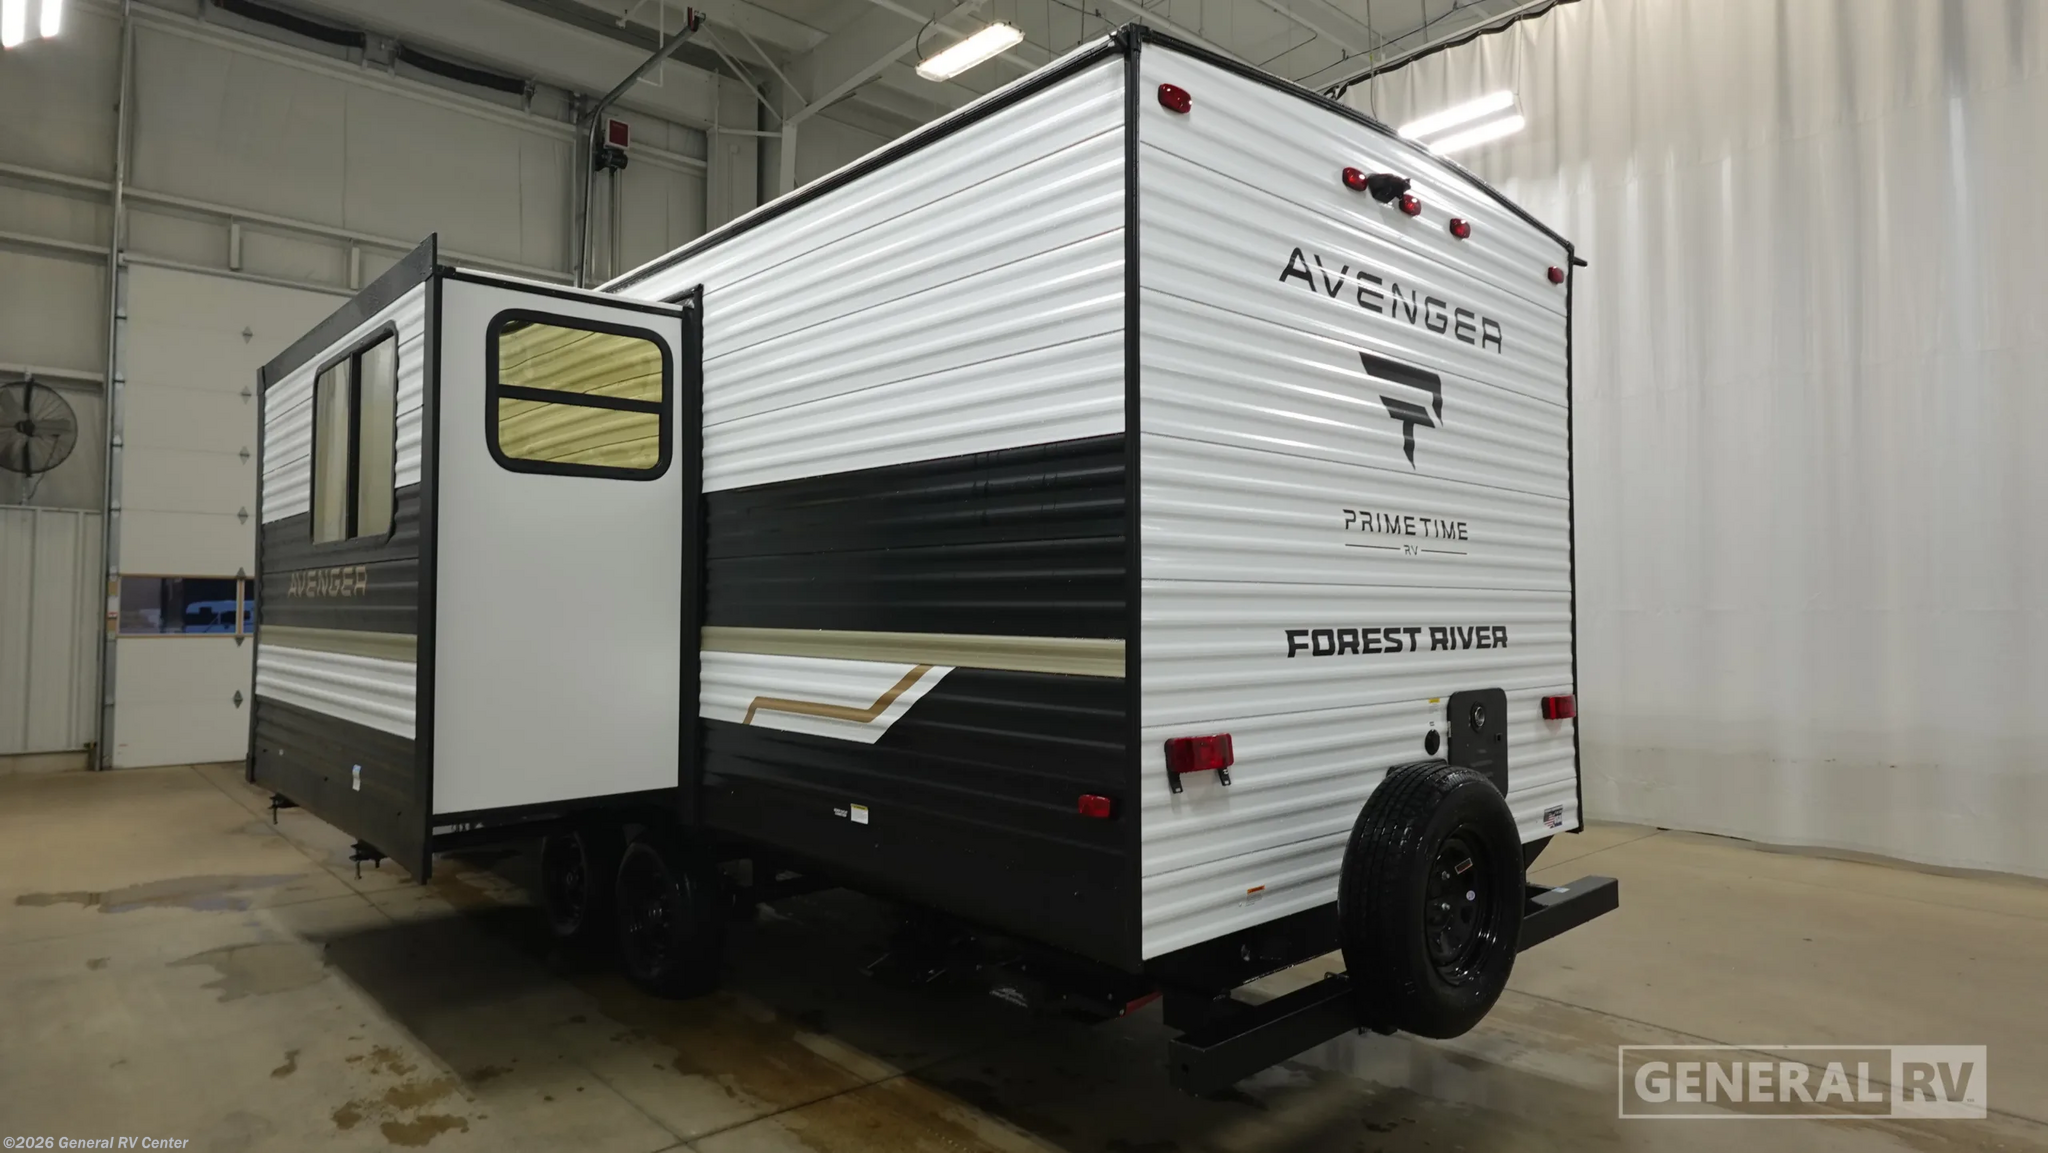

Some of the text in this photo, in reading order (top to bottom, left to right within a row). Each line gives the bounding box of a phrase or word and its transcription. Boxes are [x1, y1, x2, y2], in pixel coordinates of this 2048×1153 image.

[1279, 247, 1502, 354] AVENGER
[1342, 509, 1468, 541] PRIMETIME
[1403, 545, 1418, 556] RV
[287, 566, 367, 598] AVENGER
[1285, 626, 1508, 658] FOREST RIVER
